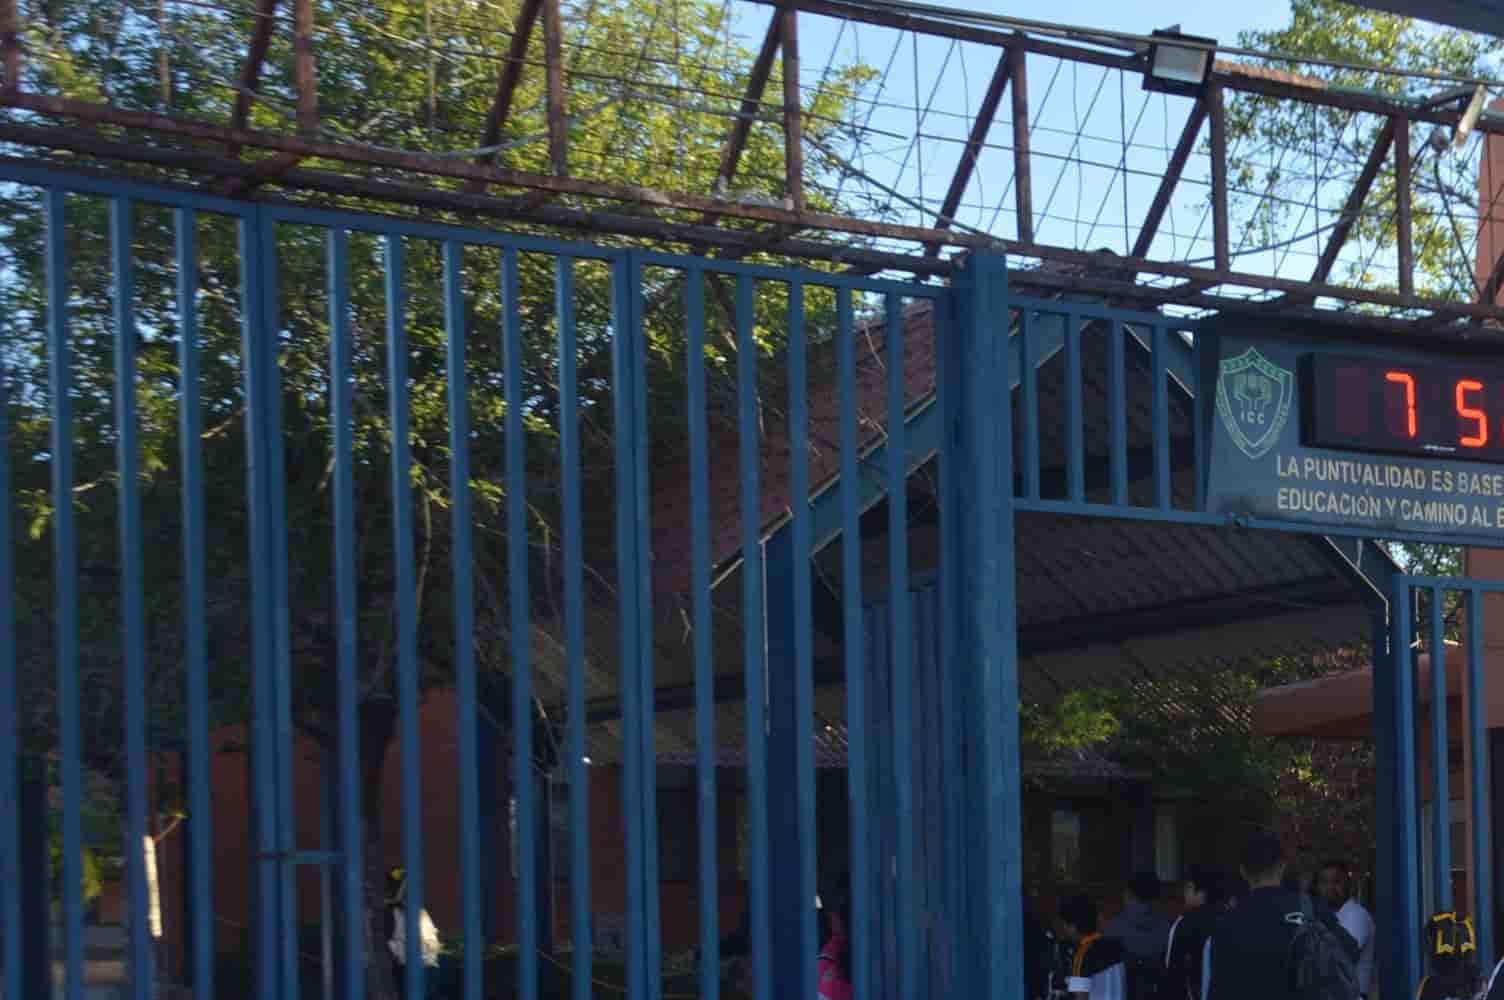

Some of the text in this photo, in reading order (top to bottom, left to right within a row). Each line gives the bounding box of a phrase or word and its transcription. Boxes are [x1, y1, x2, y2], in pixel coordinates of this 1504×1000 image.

[1386, 371, 1416, 438] 7
[1277, 455, 1300, 479] LA
[1304, 457, 1425, 490] PUNTUALIDAD
[1431, 470, 1453, 493] ES
[1458, 471, 1504, 497] BASE
[1385, 497, 1397, 517] Y
[1401, 498, 1467, 526] CAMINO
[1471, 505, 1493, 528] AL
